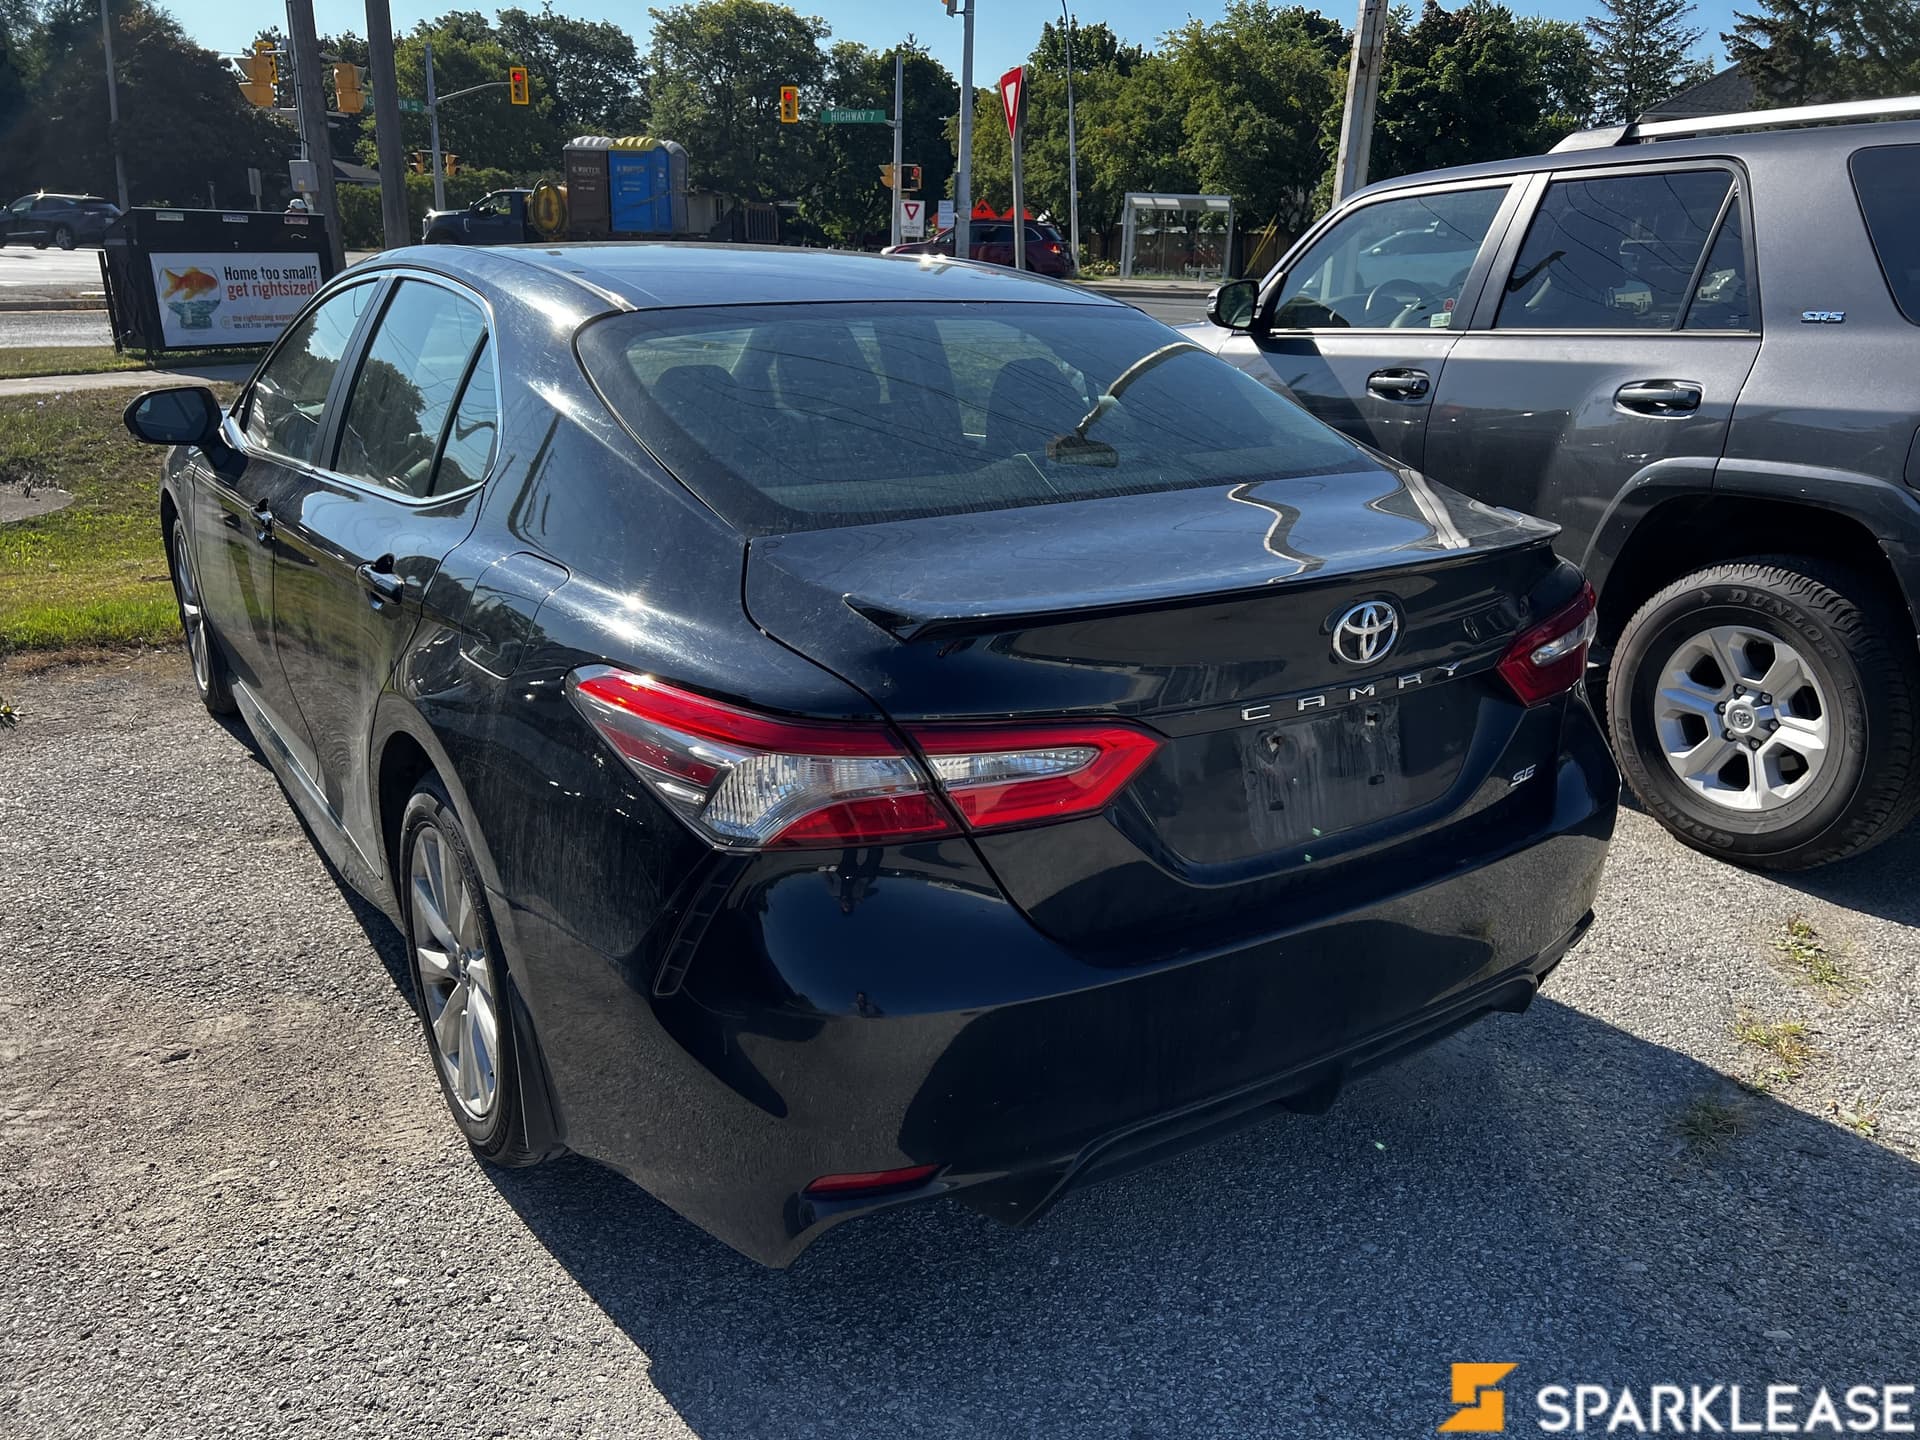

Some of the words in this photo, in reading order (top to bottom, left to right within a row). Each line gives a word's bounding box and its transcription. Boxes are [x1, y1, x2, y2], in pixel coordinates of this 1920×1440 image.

[831, 111, 866, 121] HIGHWAY
[870, 111, 875, 121] 7
[224, 266, 258, 281] Home
[261, 266, 280, 281] too
[282, 265, 317, 280] small?
[227, 282, 249, 301] get
[252, 280, 318, 300] rightsized!
[1727, 588, 1841, 661] DUNLOP
[1241, 661, 1461, 721] CAMRY
[1510, 763, 1537, 787] SE
